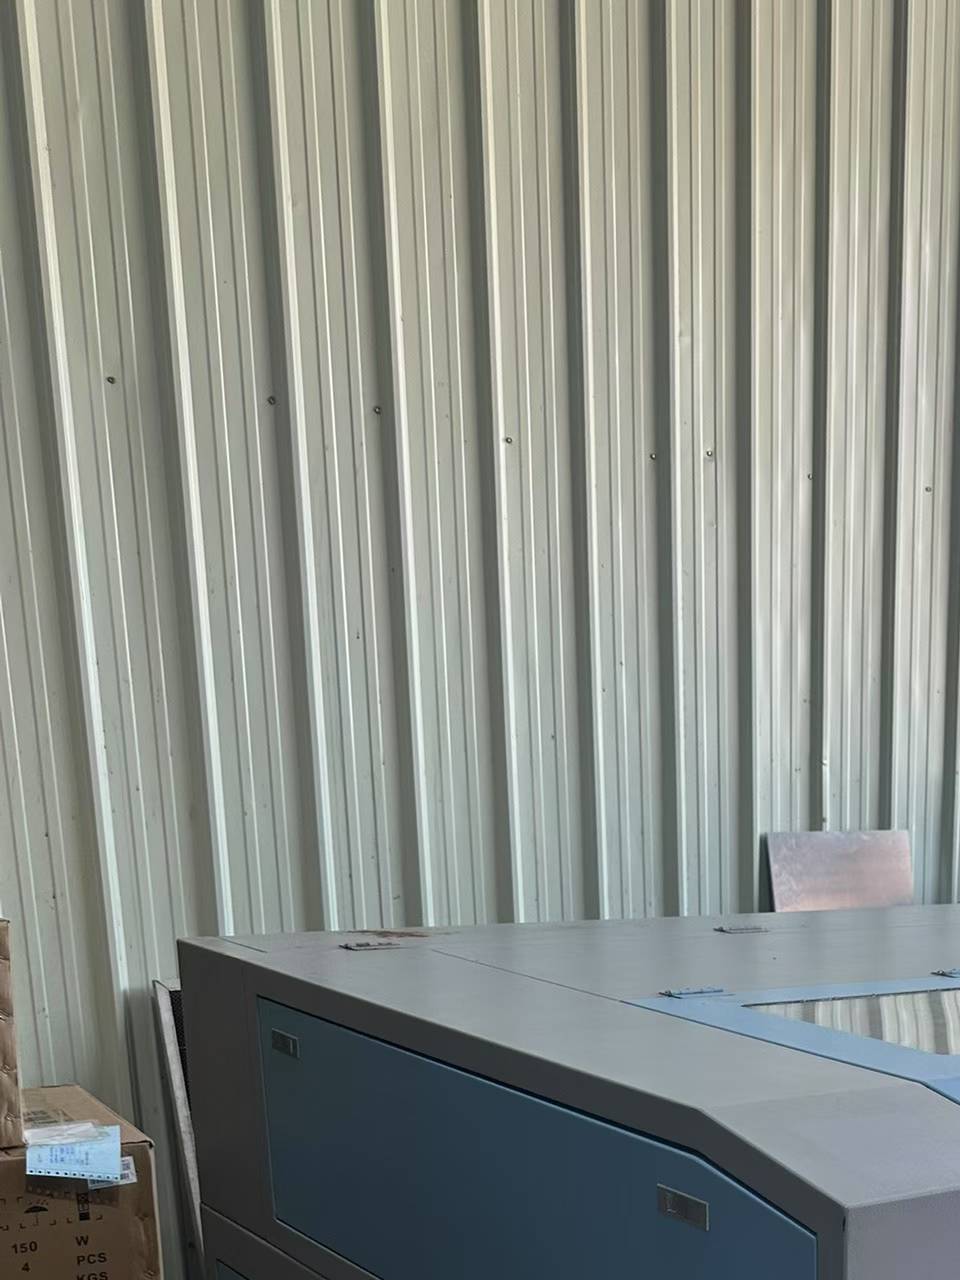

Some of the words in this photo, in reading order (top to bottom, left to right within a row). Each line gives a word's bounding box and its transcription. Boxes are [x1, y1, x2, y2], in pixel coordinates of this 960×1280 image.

[11, 1240, 38, 1254] 150
[75, 1235, 89, 1246] W
[21, 1262, 31, 1272] 4
[76, 1252, 107, 1266] PCS
